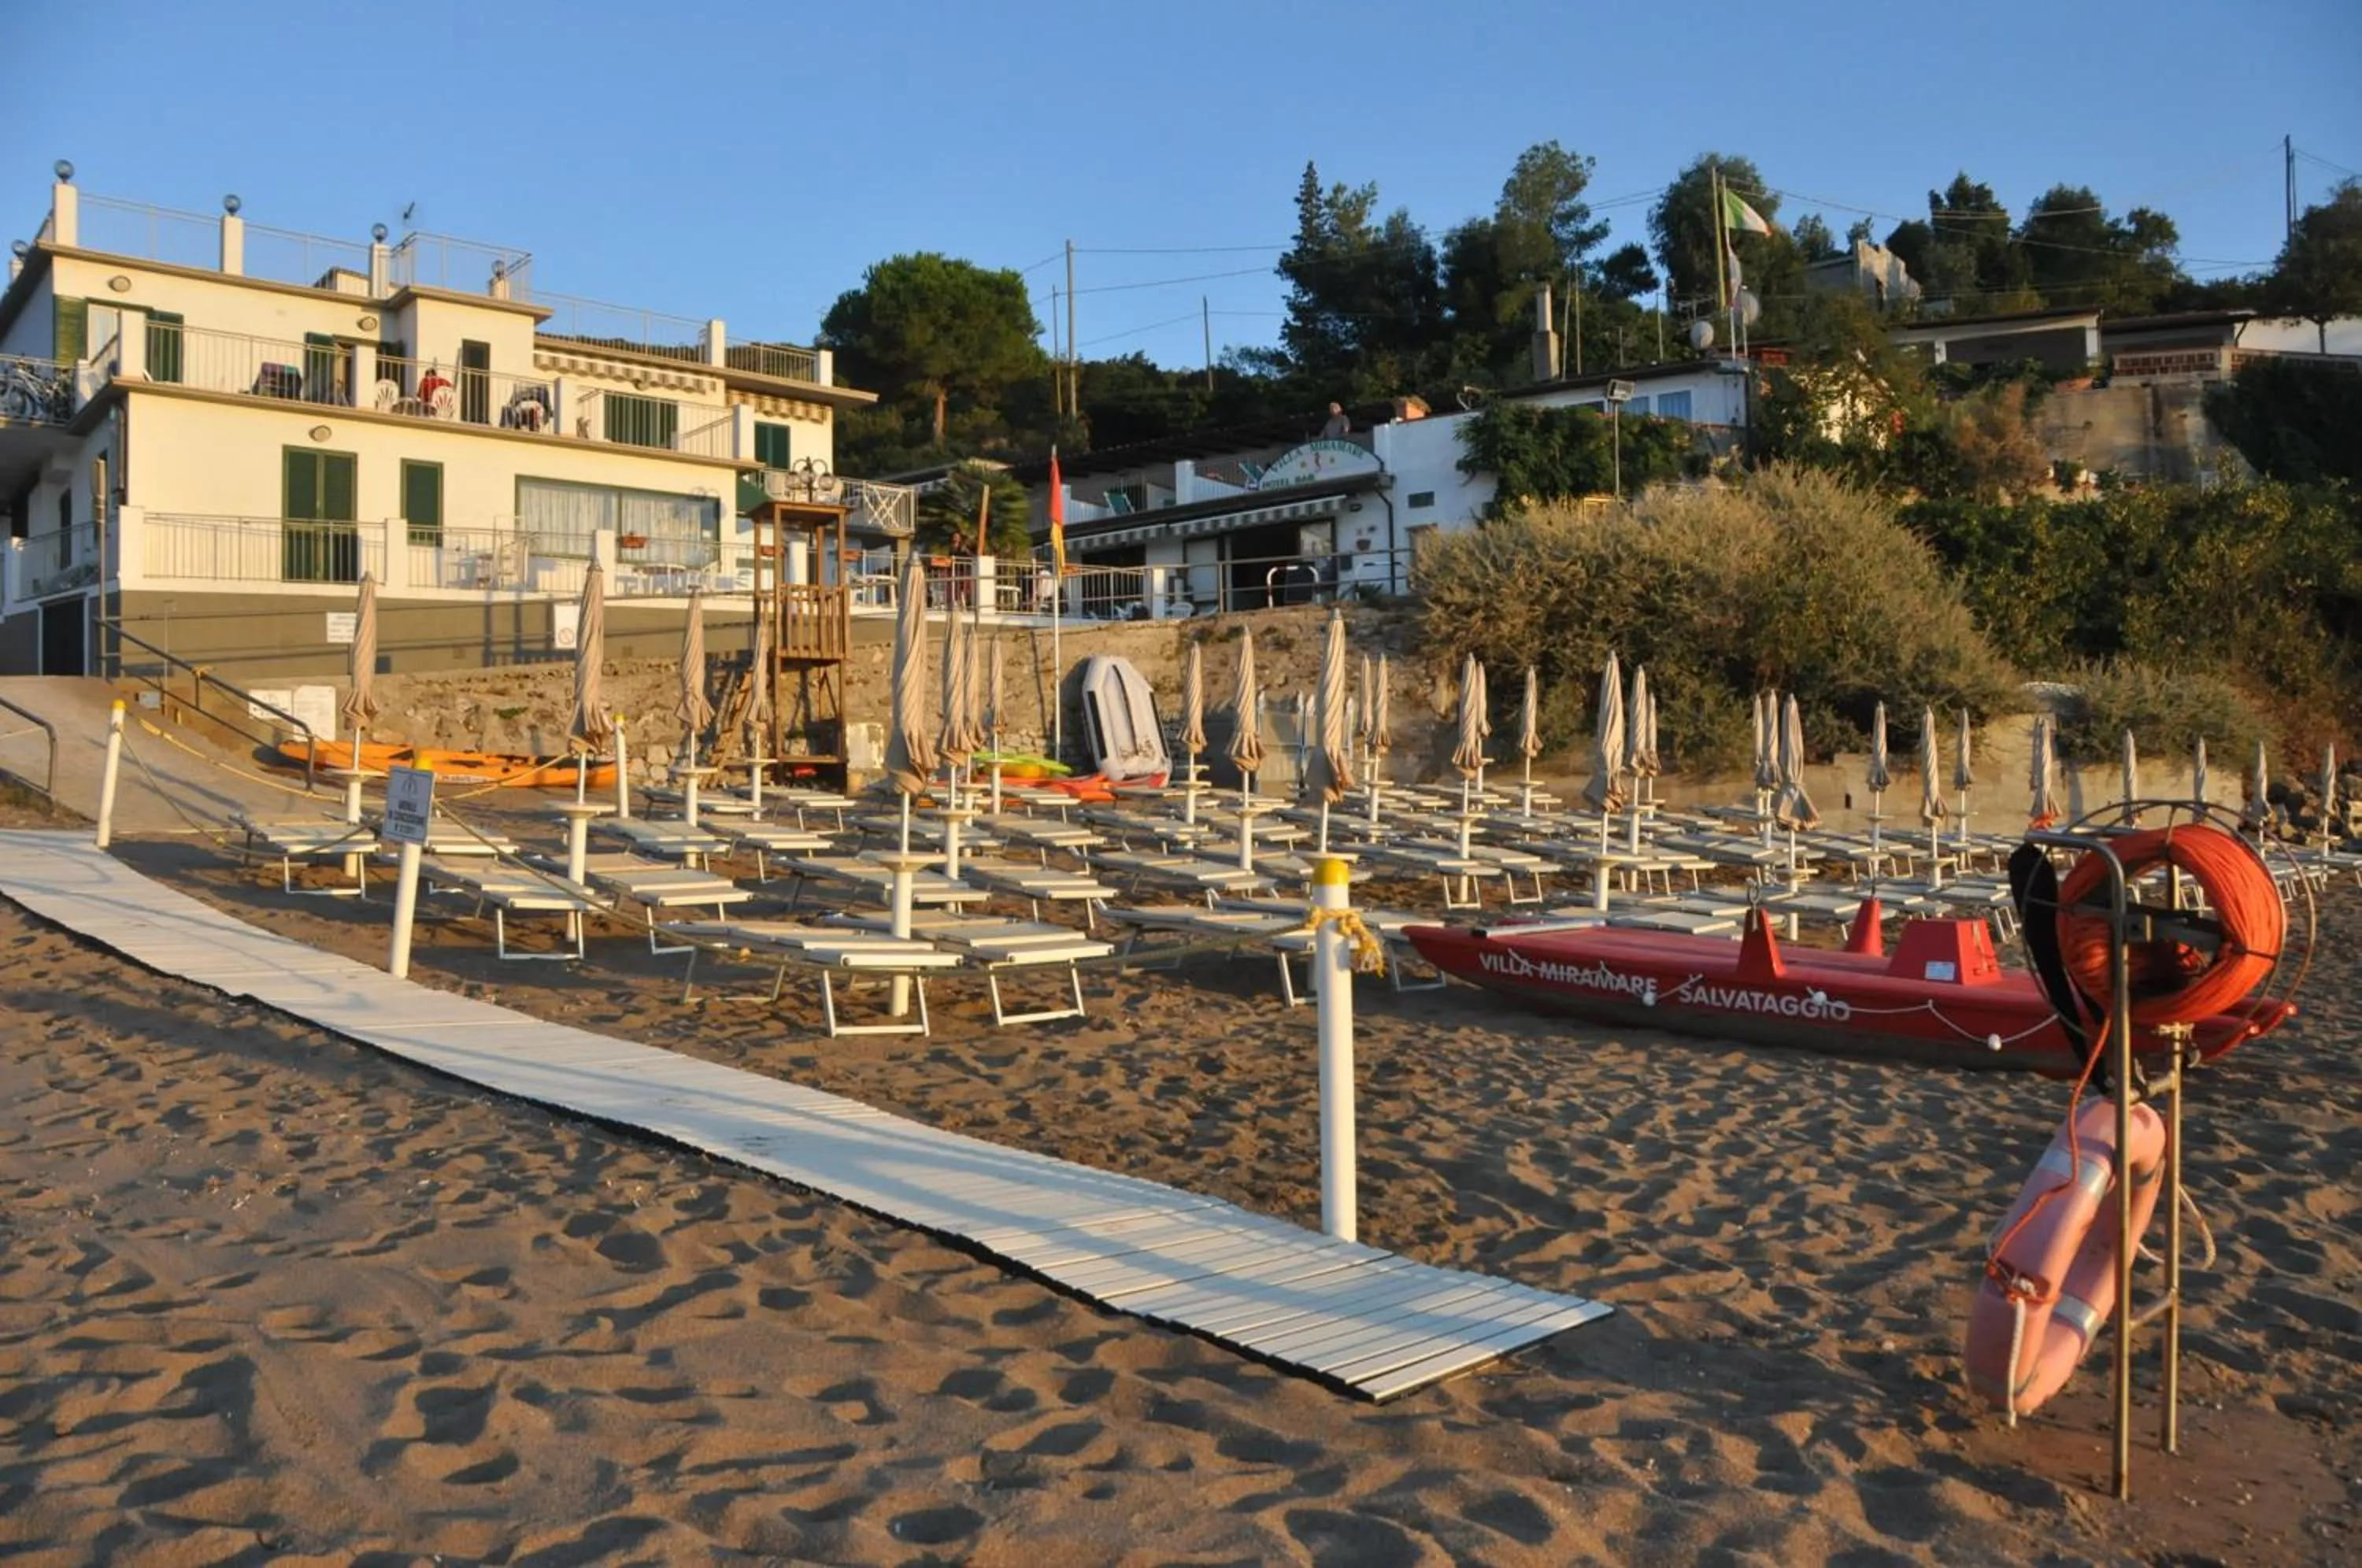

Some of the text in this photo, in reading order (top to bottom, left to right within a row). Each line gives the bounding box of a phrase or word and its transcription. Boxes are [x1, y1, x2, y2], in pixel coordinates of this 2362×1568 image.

[1261, 477, 1290, 489] HOTEL
[1479, 952, 1851, 1022] VILLA MIRAMARE SALVATAGGIO
